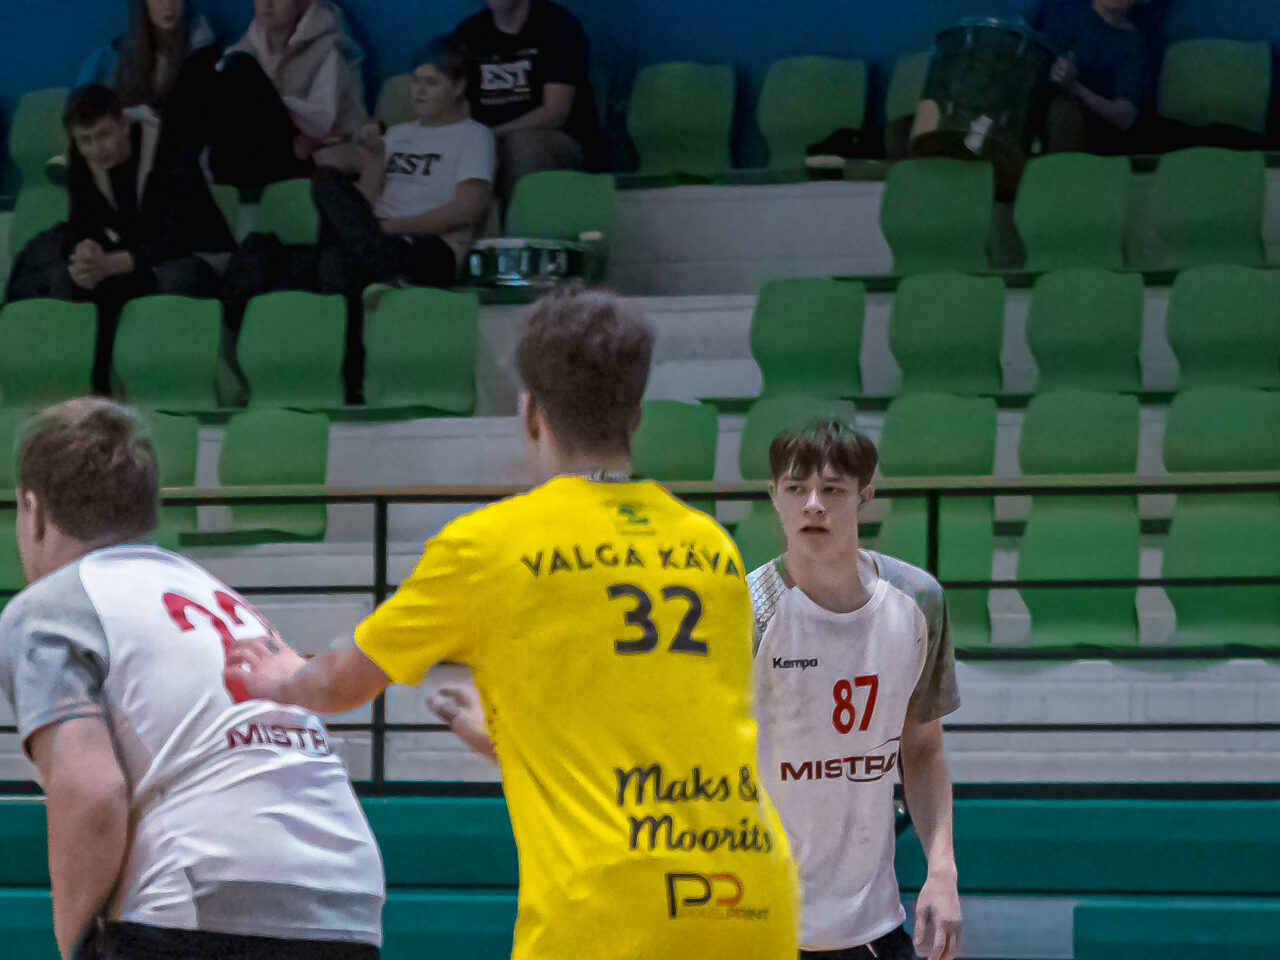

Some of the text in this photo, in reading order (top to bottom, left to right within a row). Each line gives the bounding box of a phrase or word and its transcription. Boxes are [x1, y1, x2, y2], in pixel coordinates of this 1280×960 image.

[480, 60, 532, 91] EST
[521, 543, 645, 577] VALGA
[607, 583, 709, 655] 32
[772, 657, 818, 671] Kempa
[832, 674, 879, 734] 87
[616, 763, 730, 807] Maks
[629, 814, 773, 853] Moorits
